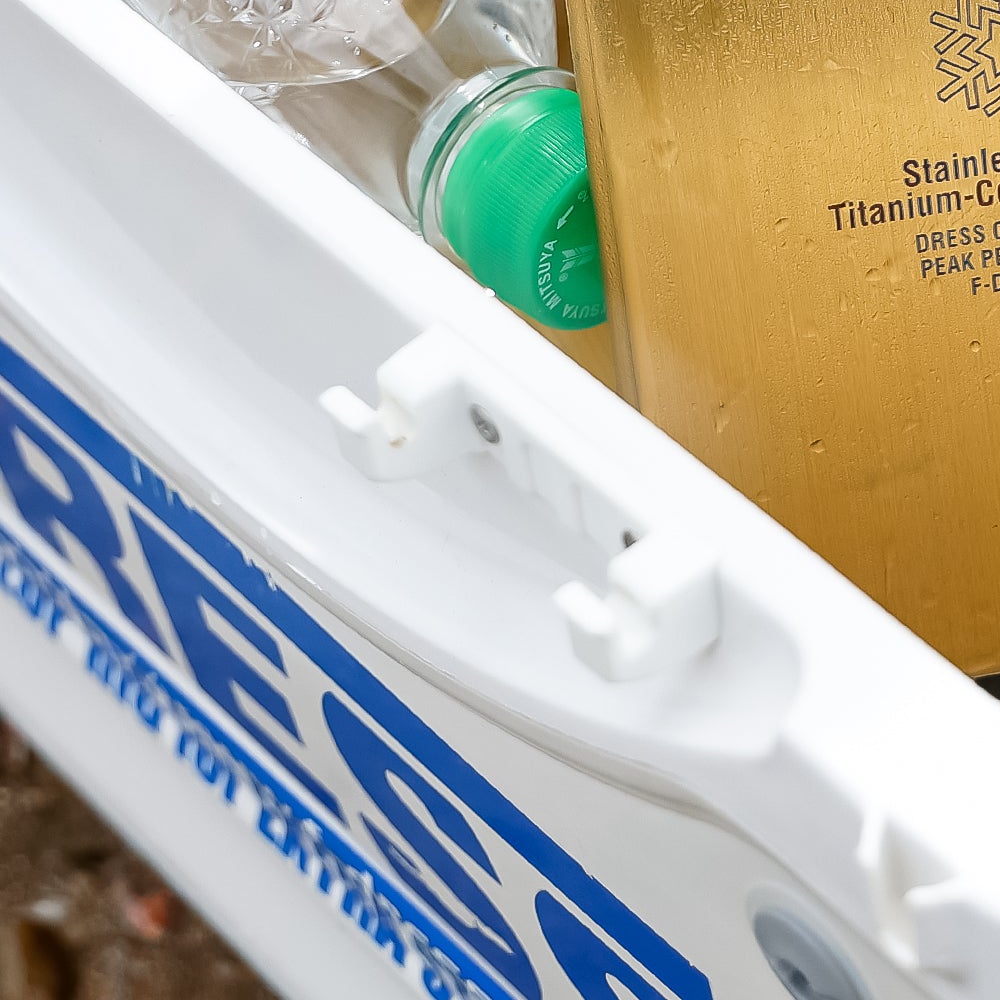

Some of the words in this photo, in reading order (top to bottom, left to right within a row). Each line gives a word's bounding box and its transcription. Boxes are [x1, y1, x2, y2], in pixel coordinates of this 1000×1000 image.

[916, 224, 985, 253] DRESS
[538, 239, 562, 310] MITSUYA
[921, 251, 975, 278] PEAK
[562, 303, 606, 319] SUYA
[0, 380, 672, 1000] RES
